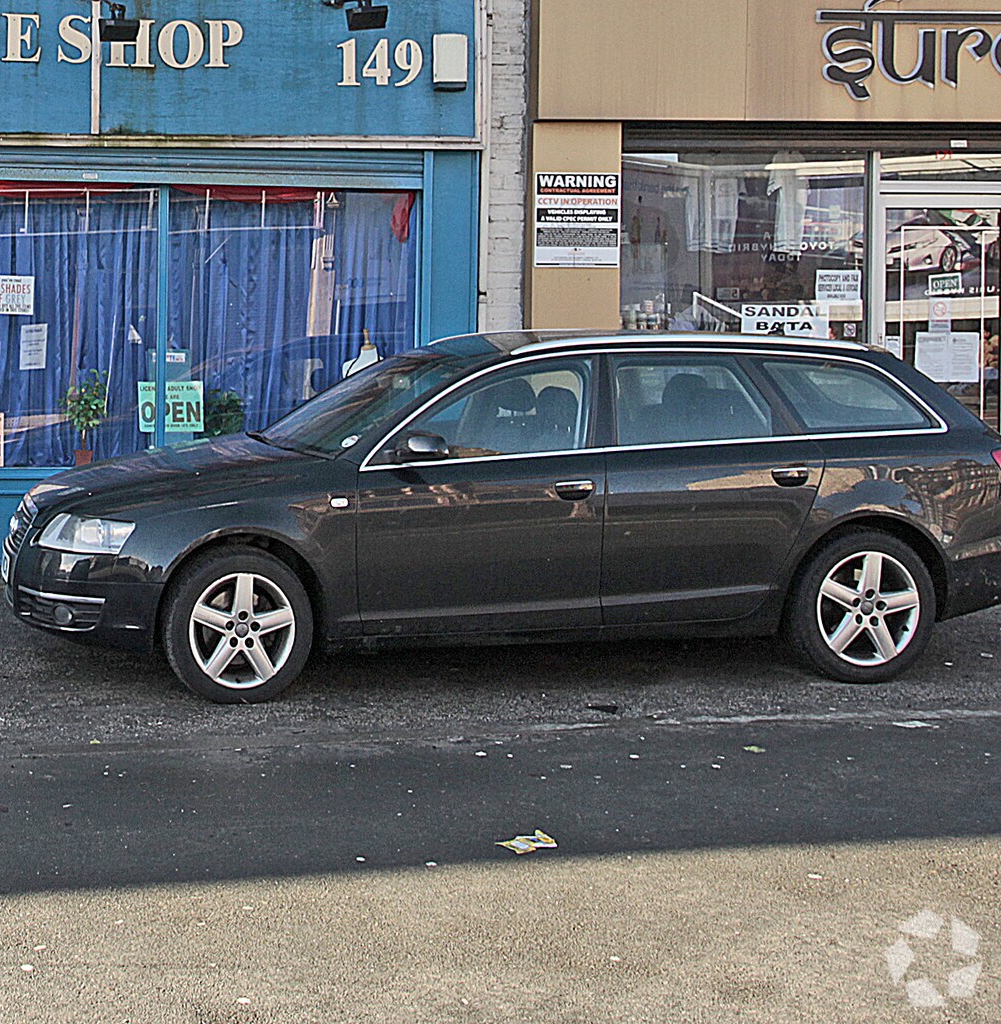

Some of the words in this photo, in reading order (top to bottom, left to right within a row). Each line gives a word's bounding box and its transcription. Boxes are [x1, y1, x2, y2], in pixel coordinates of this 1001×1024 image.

[57, 15, 243, 69] SHOP
[336, 37, 423, 87] 149
[538, 175, 616, 188] WARNING
[1, 284, 31, 294] SHADES
[933, 279, 958, 289] OPEN
[6, 294, 26, 304] GREY
[756, 322, 812, 331] BATA
